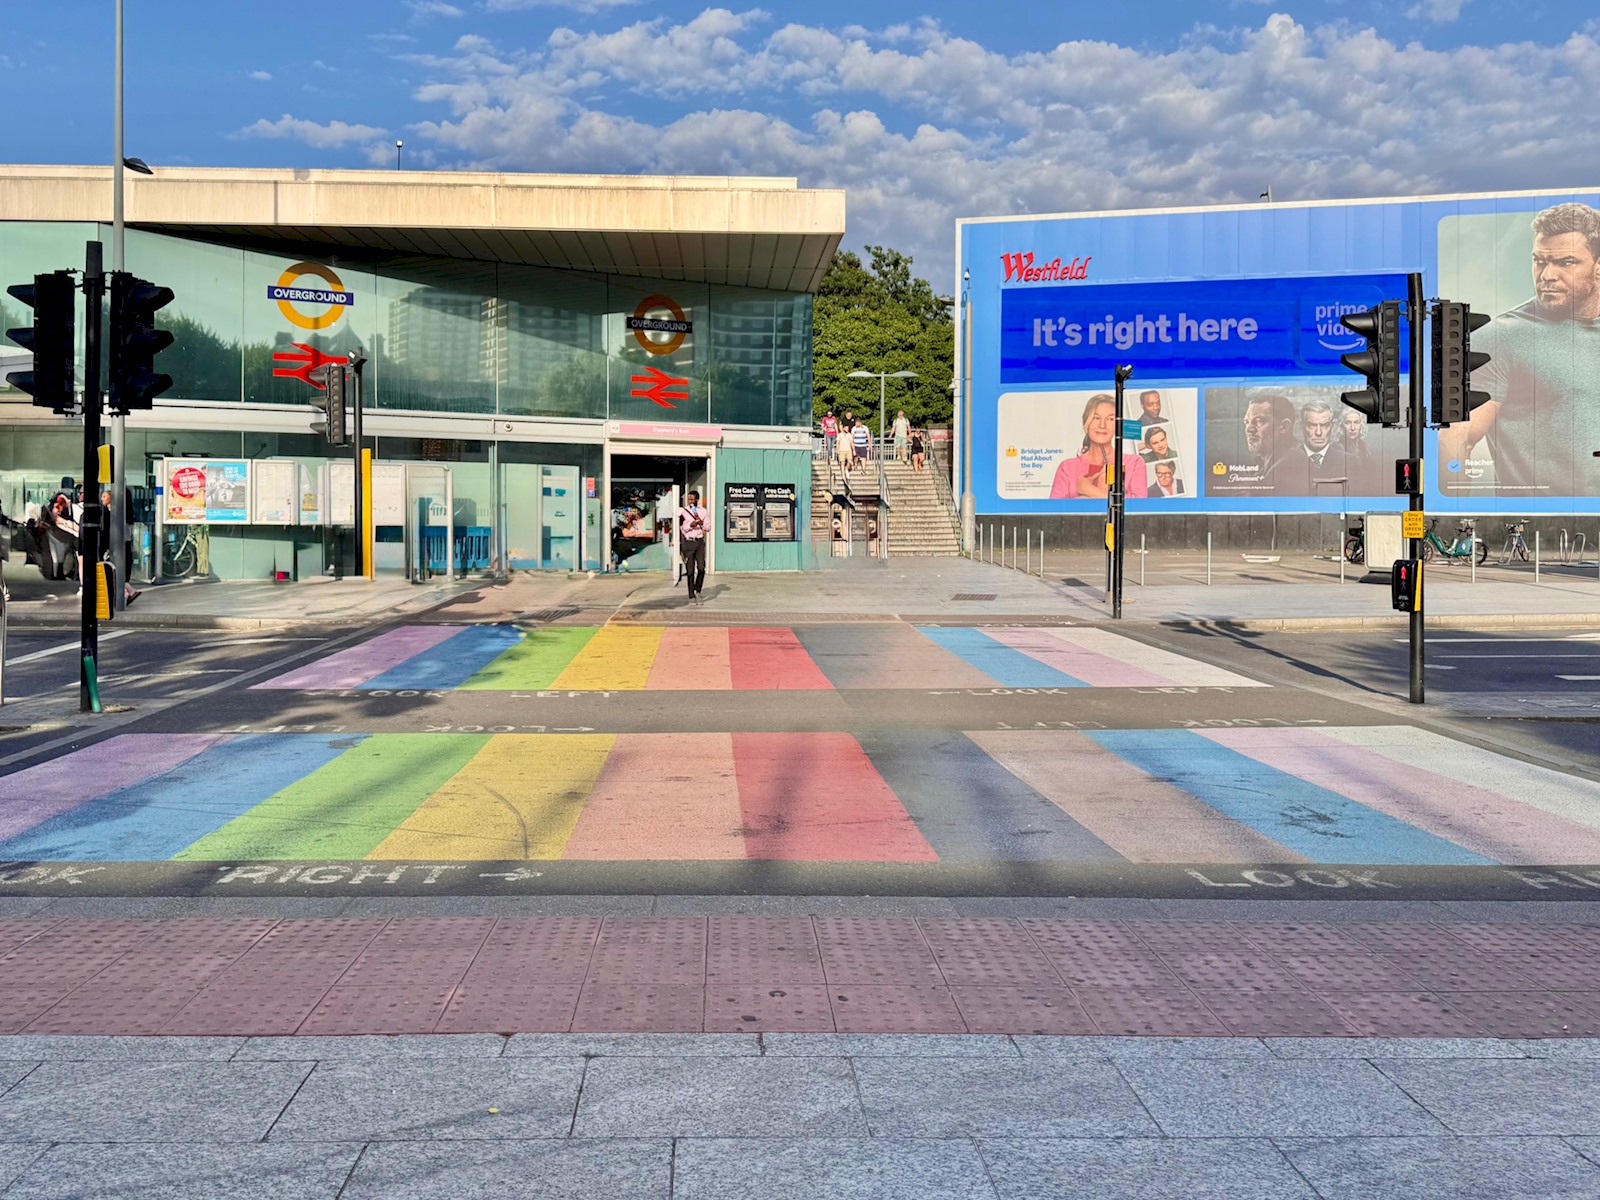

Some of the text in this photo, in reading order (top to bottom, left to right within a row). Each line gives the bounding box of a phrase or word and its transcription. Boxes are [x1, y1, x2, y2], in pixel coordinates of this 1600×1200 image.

[1000, 251, 1092, 283] Westfield
[273, 288, 347, 303] OVERGROUND
[630, 319, 687, 331] OVERGROUND
[1088, 314, 1172, 351] right
[1178, 313, 1259, 342] here
[1464, 458, 1494, 466] Reacher
[1464, 467, 1484, 475] prime
[338, 690, 619, 698] LOOK LEFT
[967, 688, 1069, 696] LOOK
[215, 865, 467, 884] RIGHT
[1184, 868, 1402, 888] LOOK
